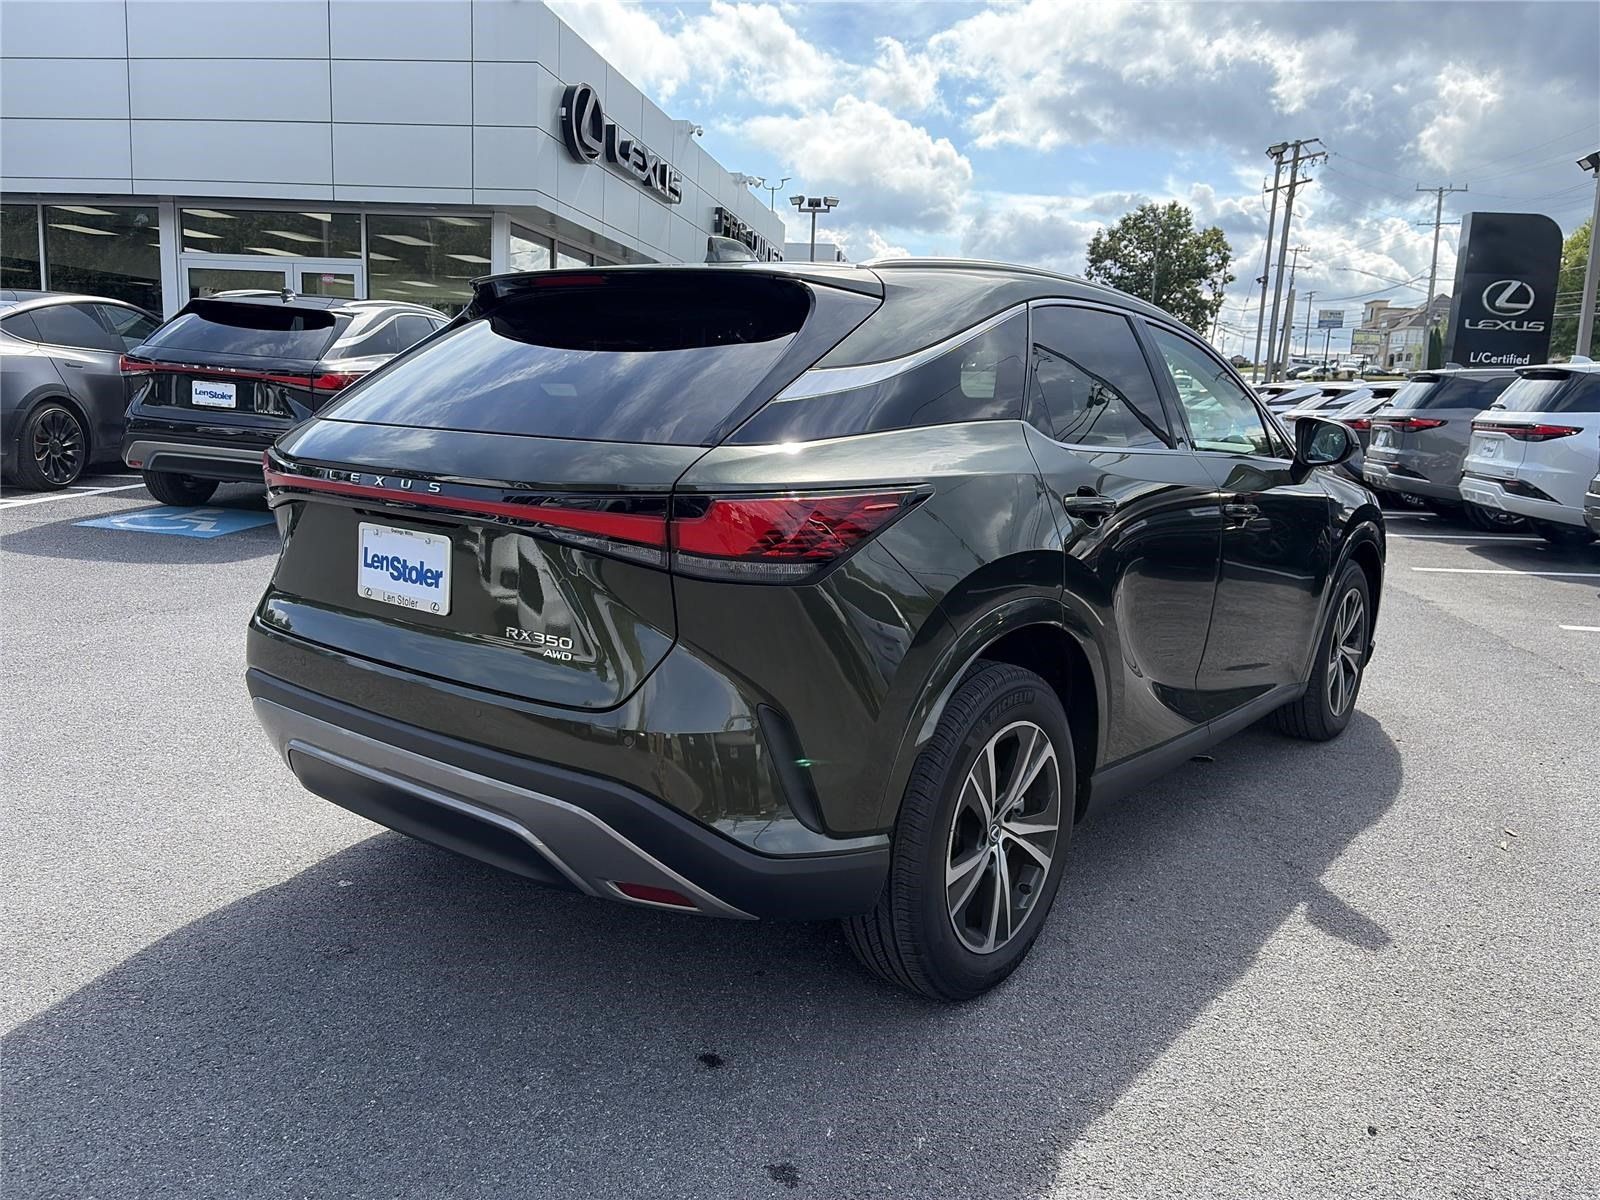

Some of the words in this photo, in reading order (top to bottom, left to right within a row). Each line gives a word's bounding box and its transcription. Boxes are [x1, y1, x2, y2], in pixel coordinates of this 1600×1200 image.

[605, 124, 682, 205] LEXUS
[1465, 319, 1545, 332] LEXUS
[1469, 352, 1530, 365] L/Certified
[329, 470, 441, 493] LEXUS
[382, 591, 396, 603] Len
[396, 594, 419, 608] Stoler
[543, 649, 572, 661] AWD
